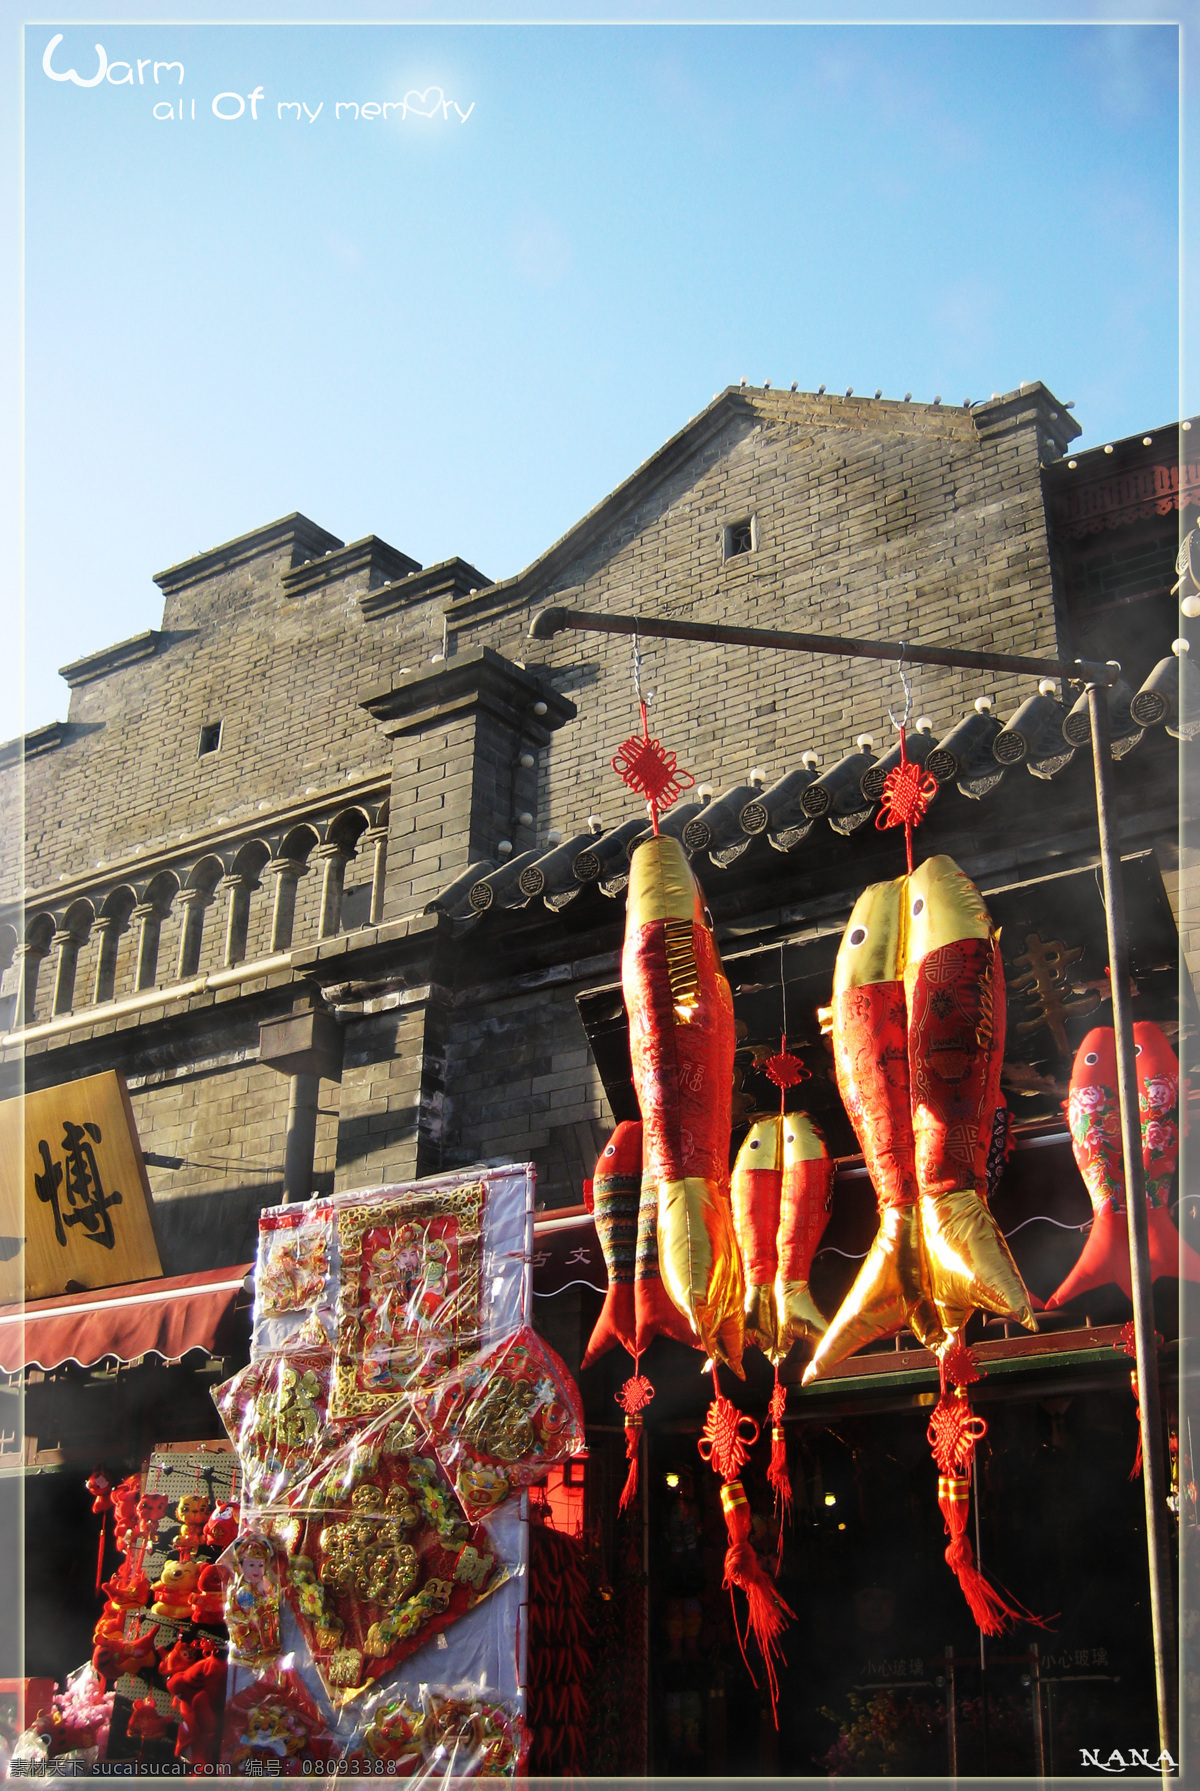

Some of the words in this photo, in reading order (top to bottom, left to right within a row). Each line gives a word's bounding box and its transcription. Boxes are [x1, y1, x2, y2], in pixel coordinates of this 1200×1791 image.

[861, 1657, 925, 1678] 小心玻璃
[1041, 1647, 1109, 1670] 小心玻璃
